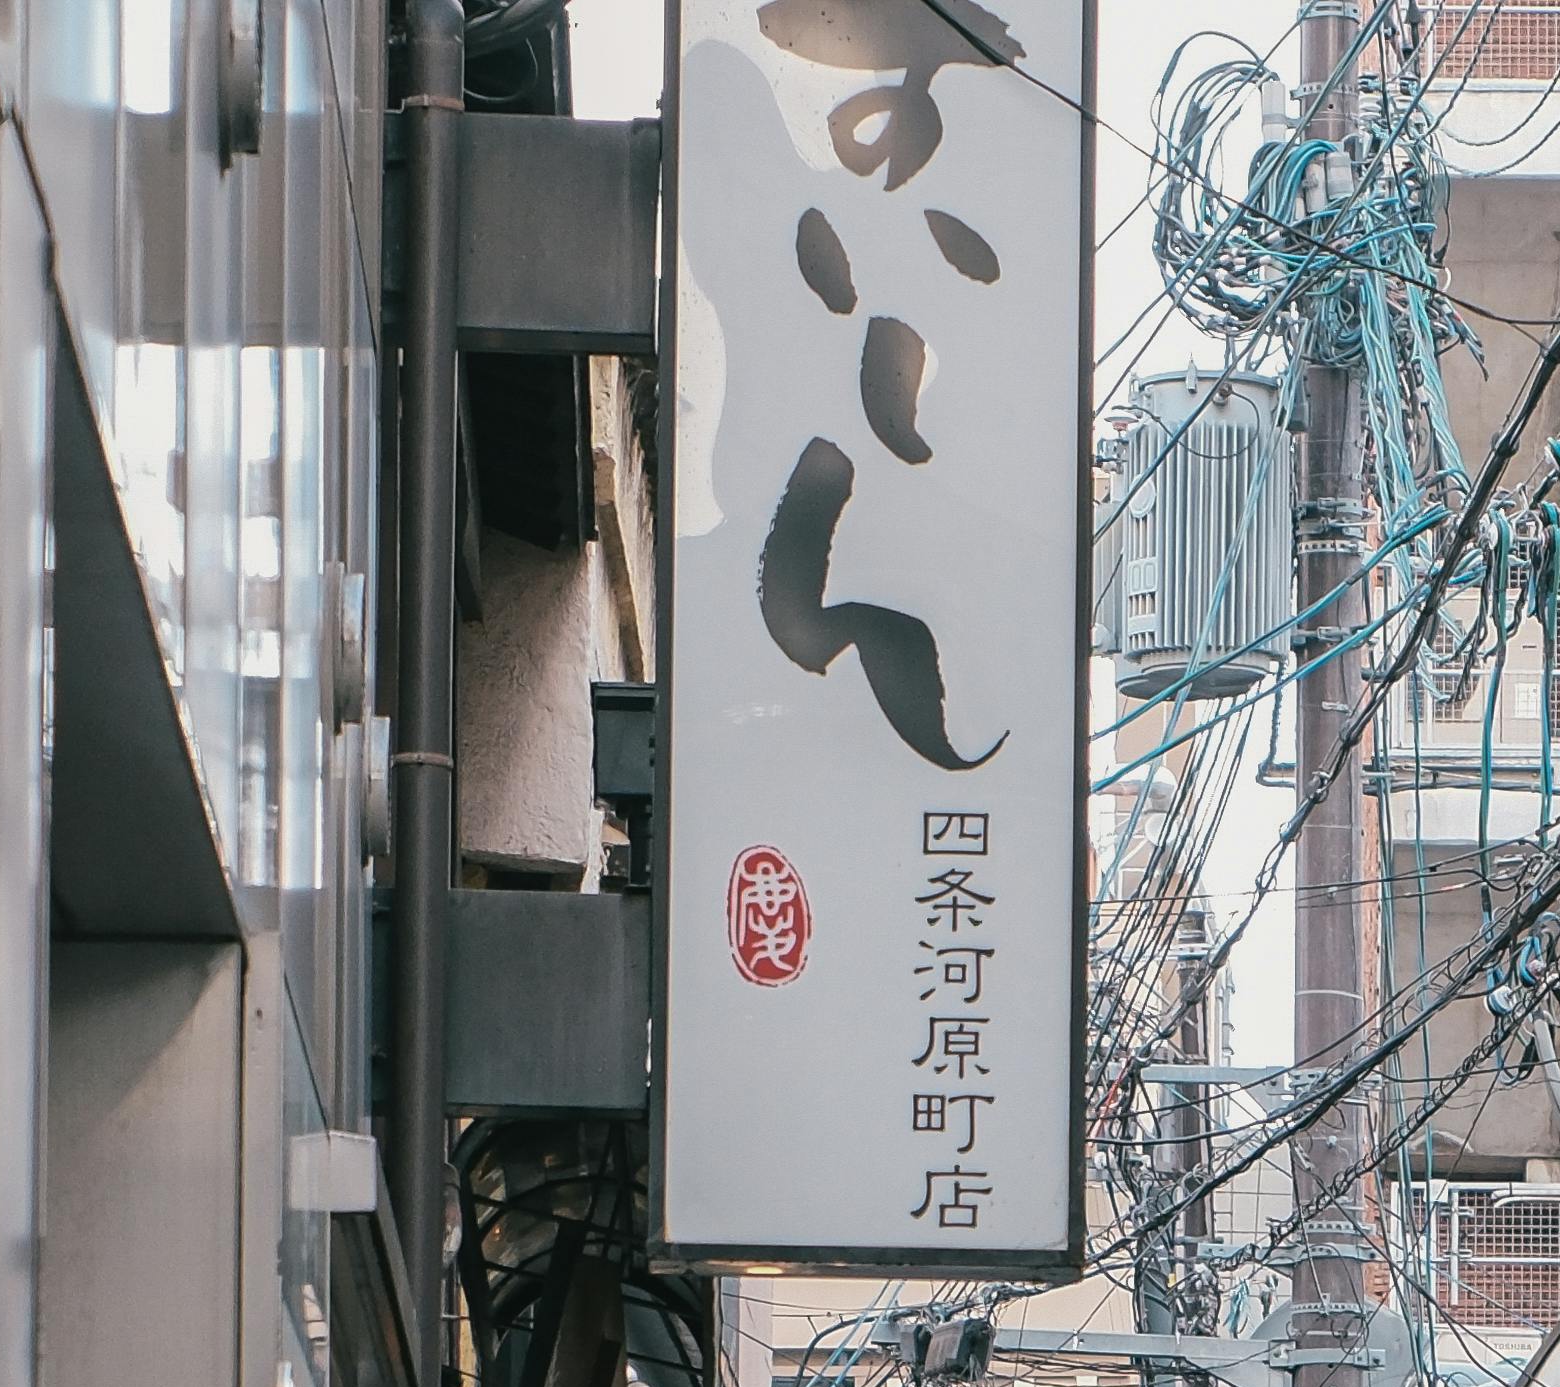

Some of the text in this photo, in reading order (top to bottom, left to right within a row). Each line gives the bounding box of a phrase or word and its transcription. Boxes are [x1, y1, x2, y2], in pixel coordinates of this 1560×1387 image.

[908, 811, 996, 1231] 四条河原町店
